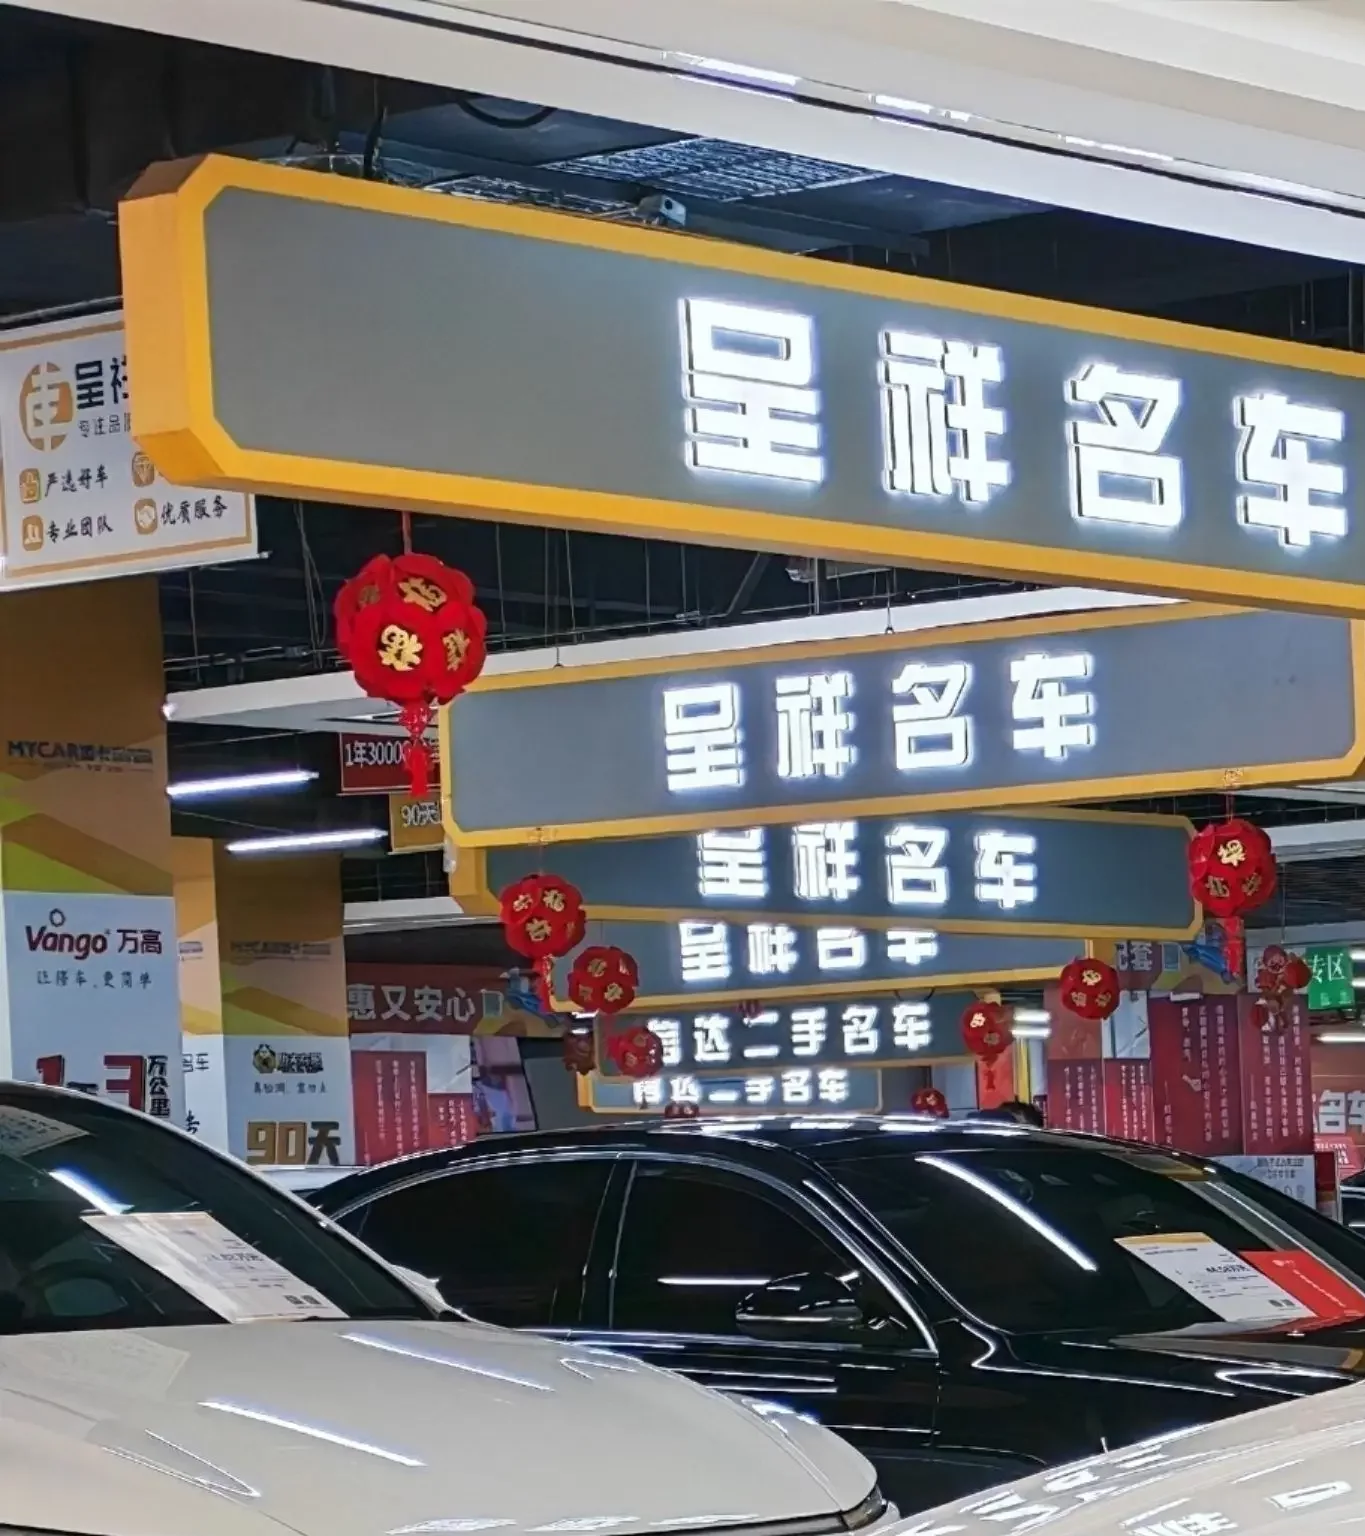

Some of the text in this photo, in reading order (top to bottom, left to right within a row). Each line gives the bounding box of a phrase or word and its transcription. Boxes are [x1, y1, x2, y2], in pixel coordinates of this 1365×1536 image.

[681, 297, 1348, 547] 呈祥名车
[47, 515, 113, 543] 专业团队
[161, 495, 228, 525] 优质服务
[664, 653, 1095, 793] 呈祥名车
[697, 820, 1037, 908] 呈祥名车
[25, 926, 108, 960] Vango
[117, 929, 162, 954] 万高
[347, 983, 476, 1022] 惠又安心
[246, 1120, 341, 1166] 90天
